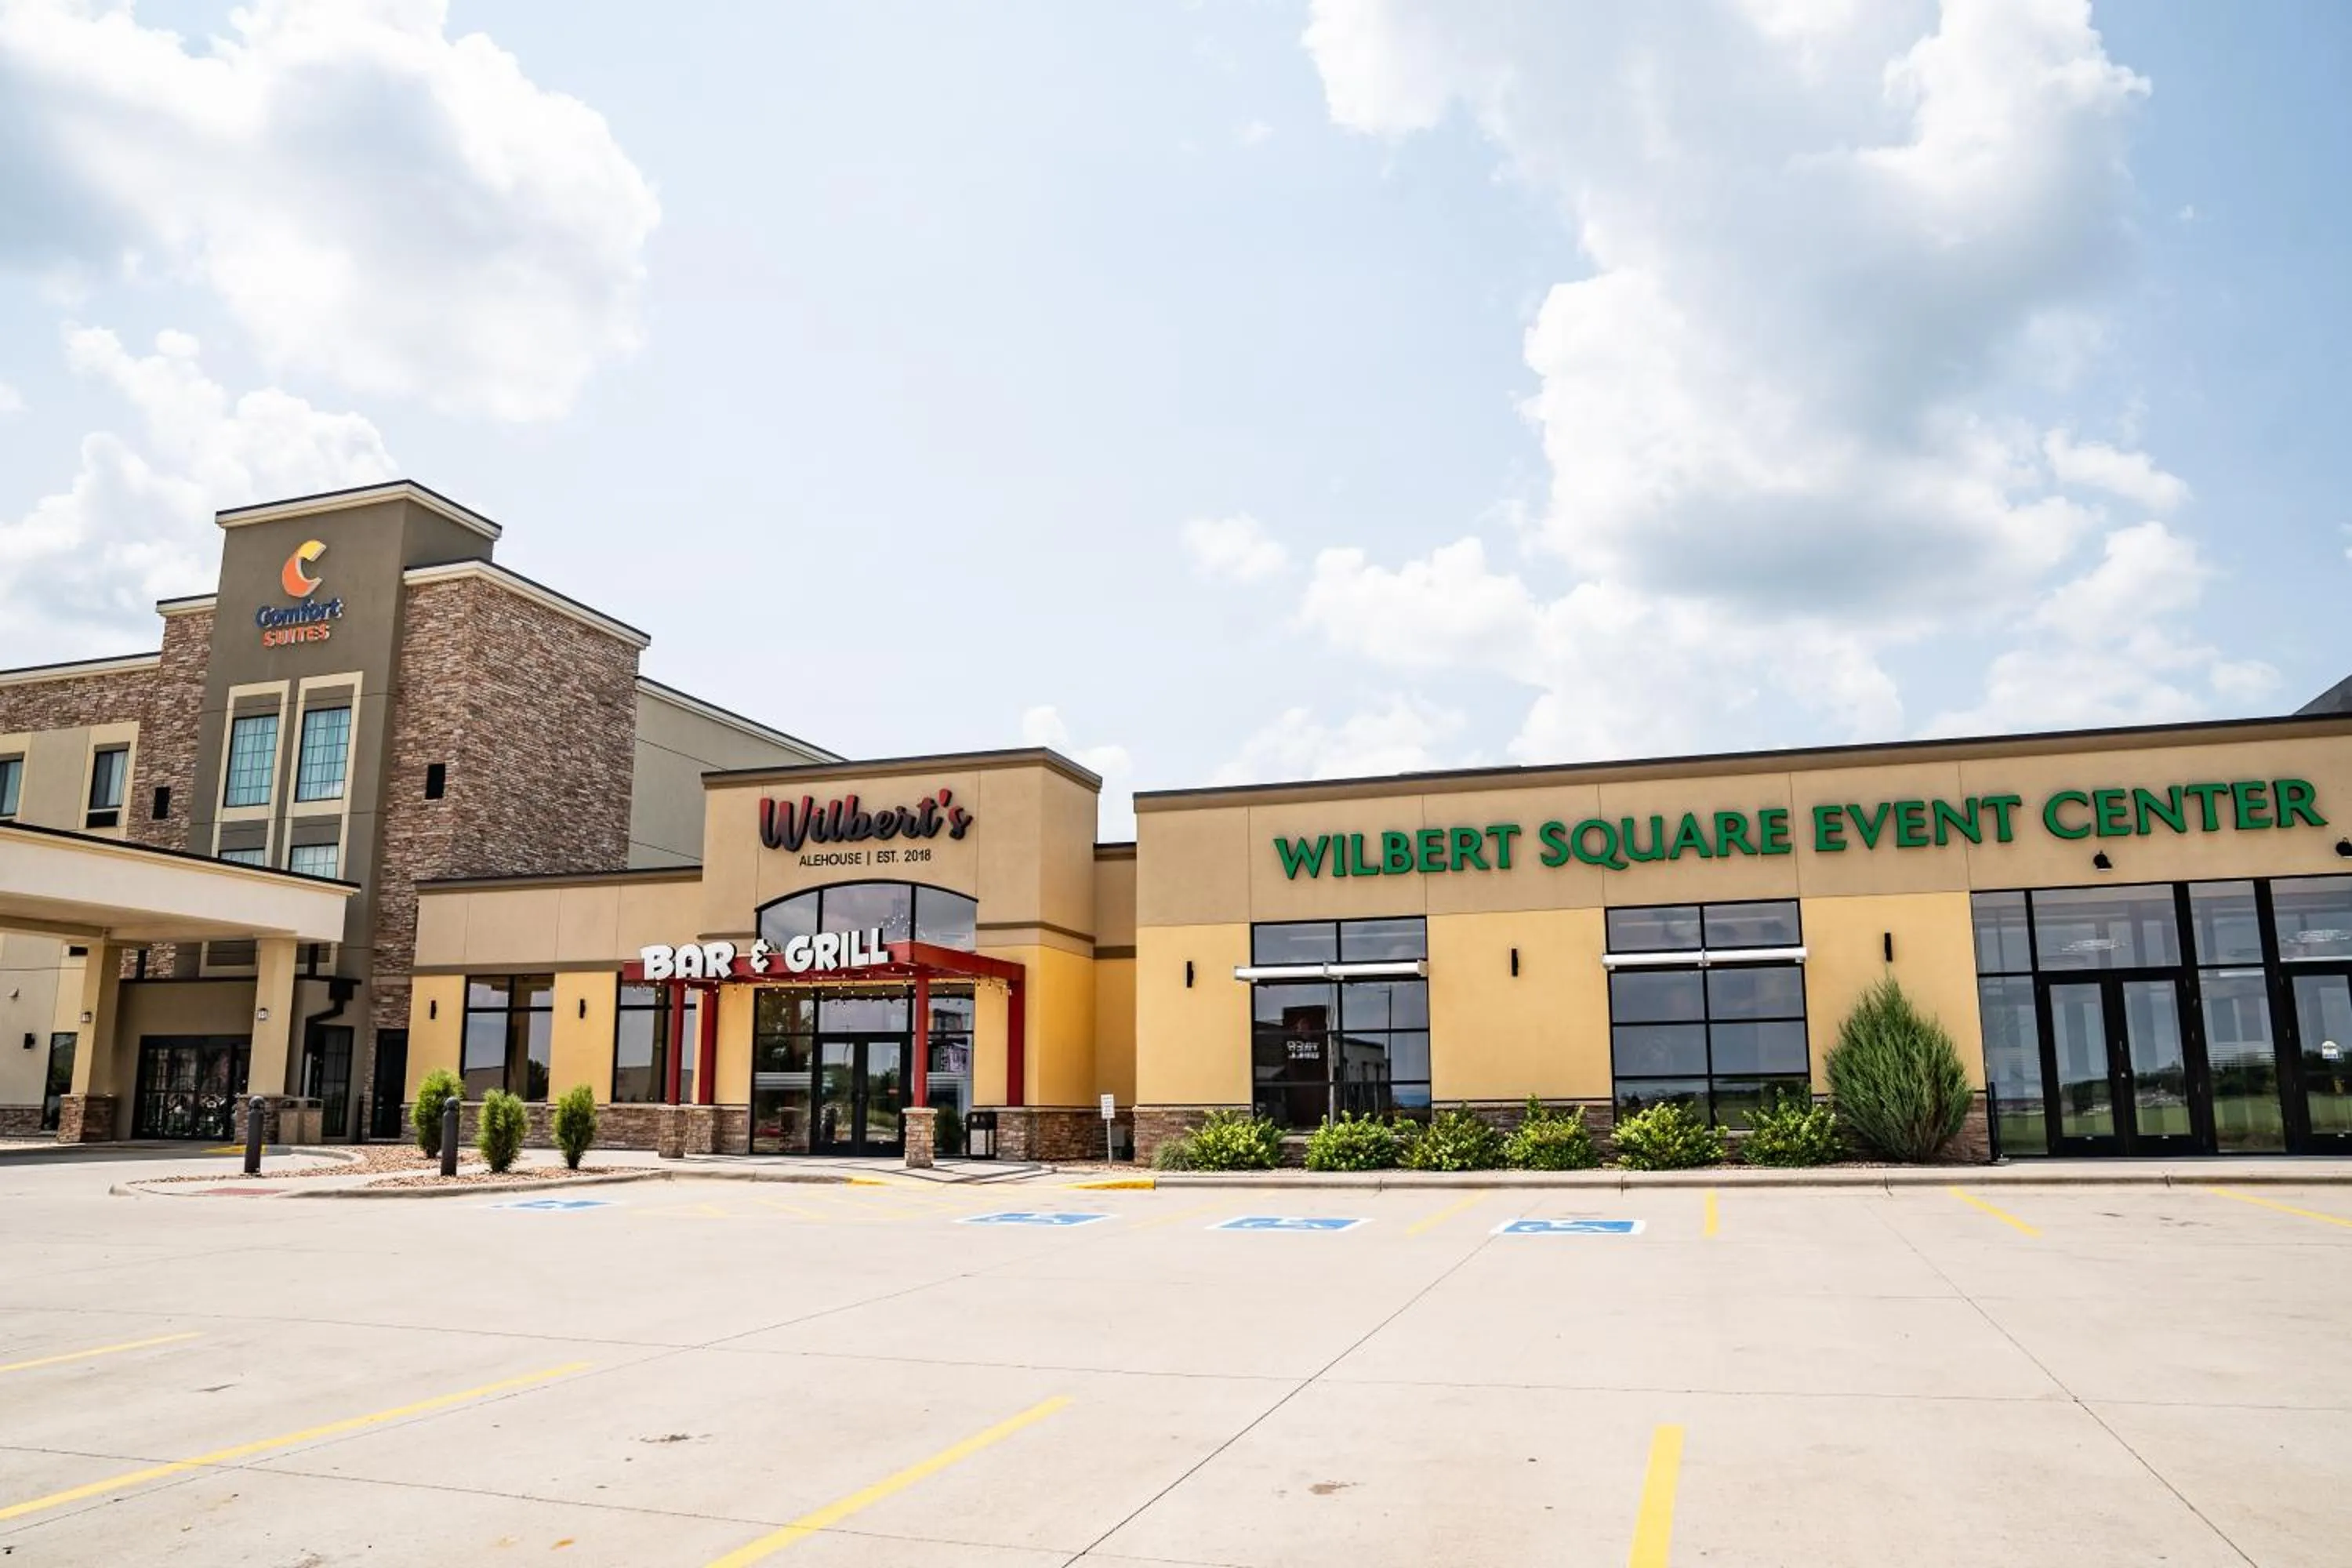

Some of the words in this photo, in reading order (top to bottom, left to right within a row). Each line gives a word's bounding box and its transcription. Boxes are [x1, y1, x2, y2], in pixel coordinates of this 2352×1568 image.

[256, 597, 343, 628] Comfort
[262, 622, 330, 647] SUITES
[759, 788, 973, 851] Wilbert's
[1274, 824, 1520, 880] WILBERT
[1539, 808, 1792, 870] SQUARE
[1813, 795, 2021, 852] EVENT
[2043, 779, 2328, 839] CENTER
[799, 852, 862, 866] ALEHOUSE
[877, 851, 899, 863] EST.
[904, 849, 931, 862] 2018
[640, 942, 737, 980] BAR
[750, 938, 771, 972] &
[785, 927, 891, 972] GRILL
